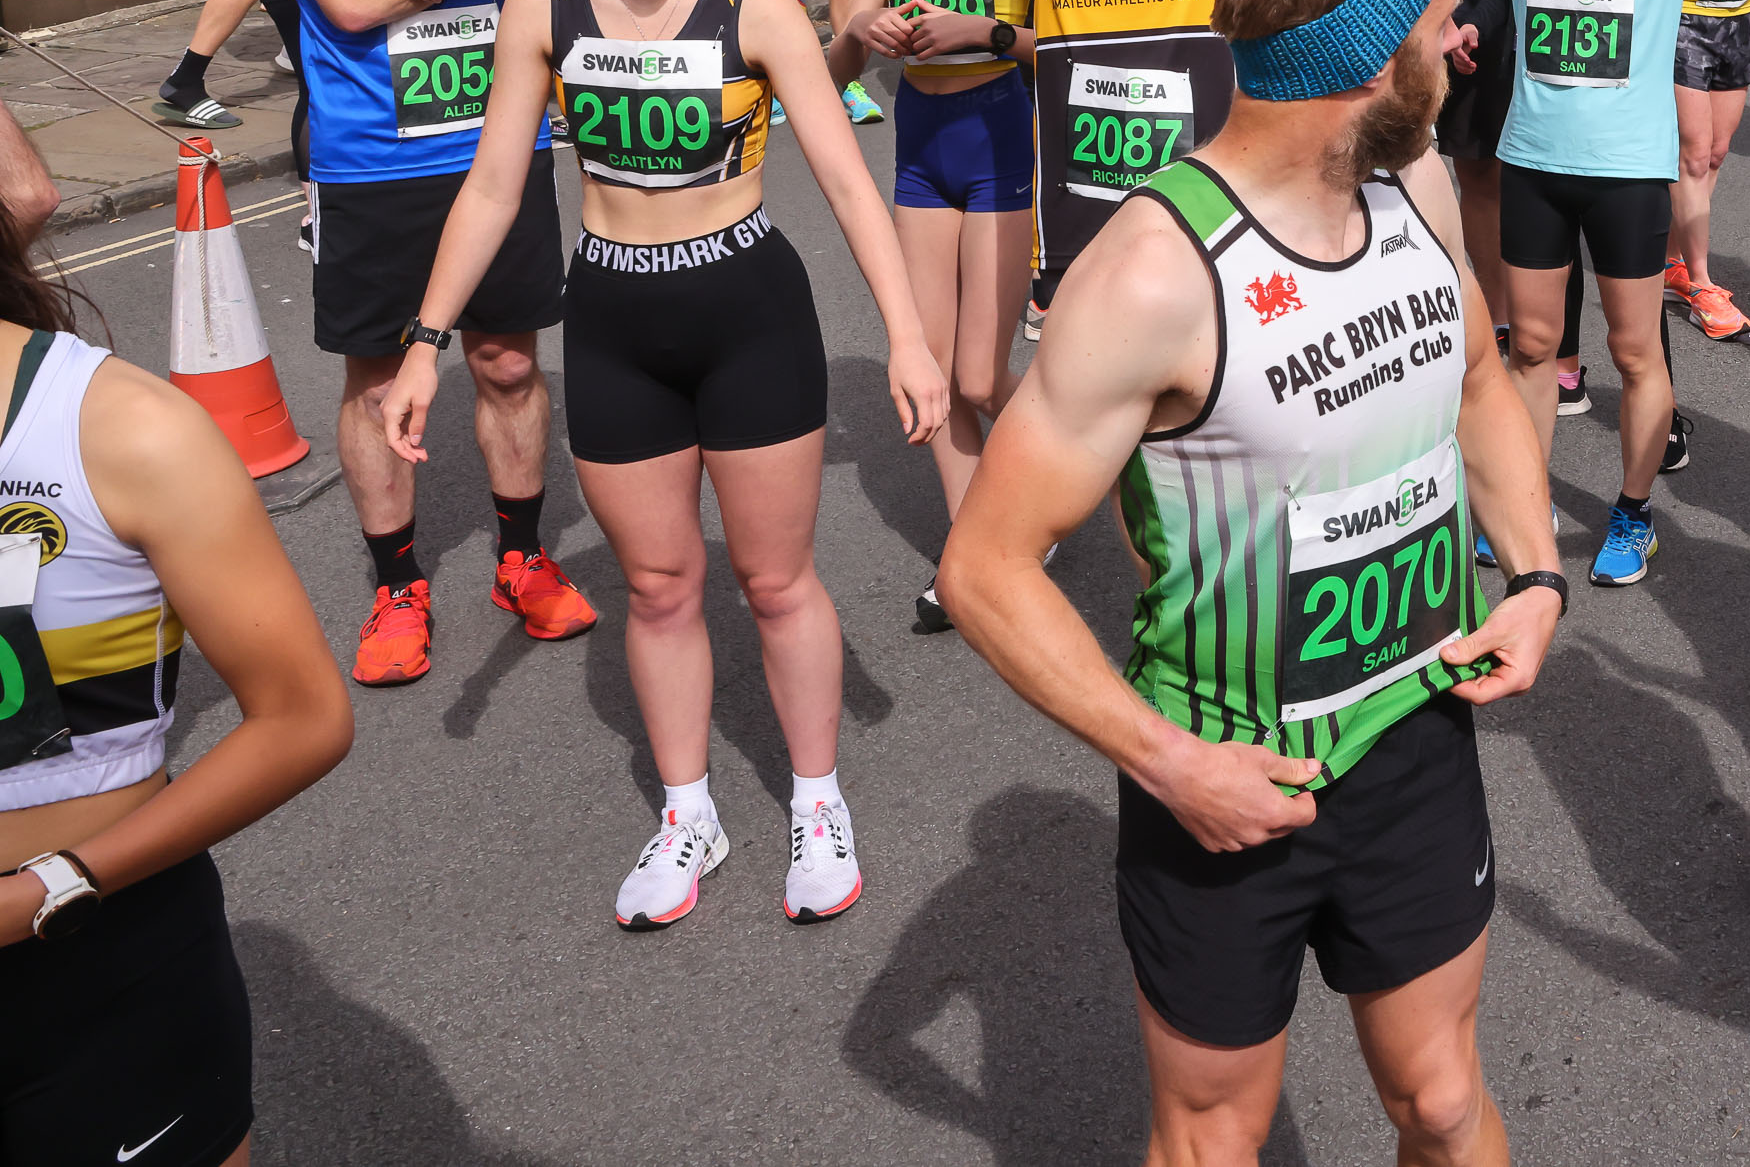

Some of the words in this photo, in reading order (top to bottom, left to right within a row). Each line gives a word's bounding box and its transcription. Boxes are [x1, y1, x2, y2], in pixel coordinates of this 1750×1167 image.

[1530, 12, 1619, 59] 2131
[400, 50, 495, 106] 205
[1559, 61, 1586, 74] SAN
[443, 101, 483, 119] ALED
[573, 91, 710, 151] 2109
[608, 153, 683, 170] CAITLYN
[1073, 112, 1183, 168] 2087
[1092, 169, 1151, 186] RICHAR
[586, 231, 735, 274] GYMSHARK
[1264, 329, 1347, 405] PARC
[1353, 299, 1408, 360] BRYN
[1406, 285, 1460, 330] BACH
[1314, 354, 1405, 417] Running
[1409, 331, 1453, 369] Club
[1299, 524, 1452, 663] 2070
[1362, 635, 1408, 674] SAM
